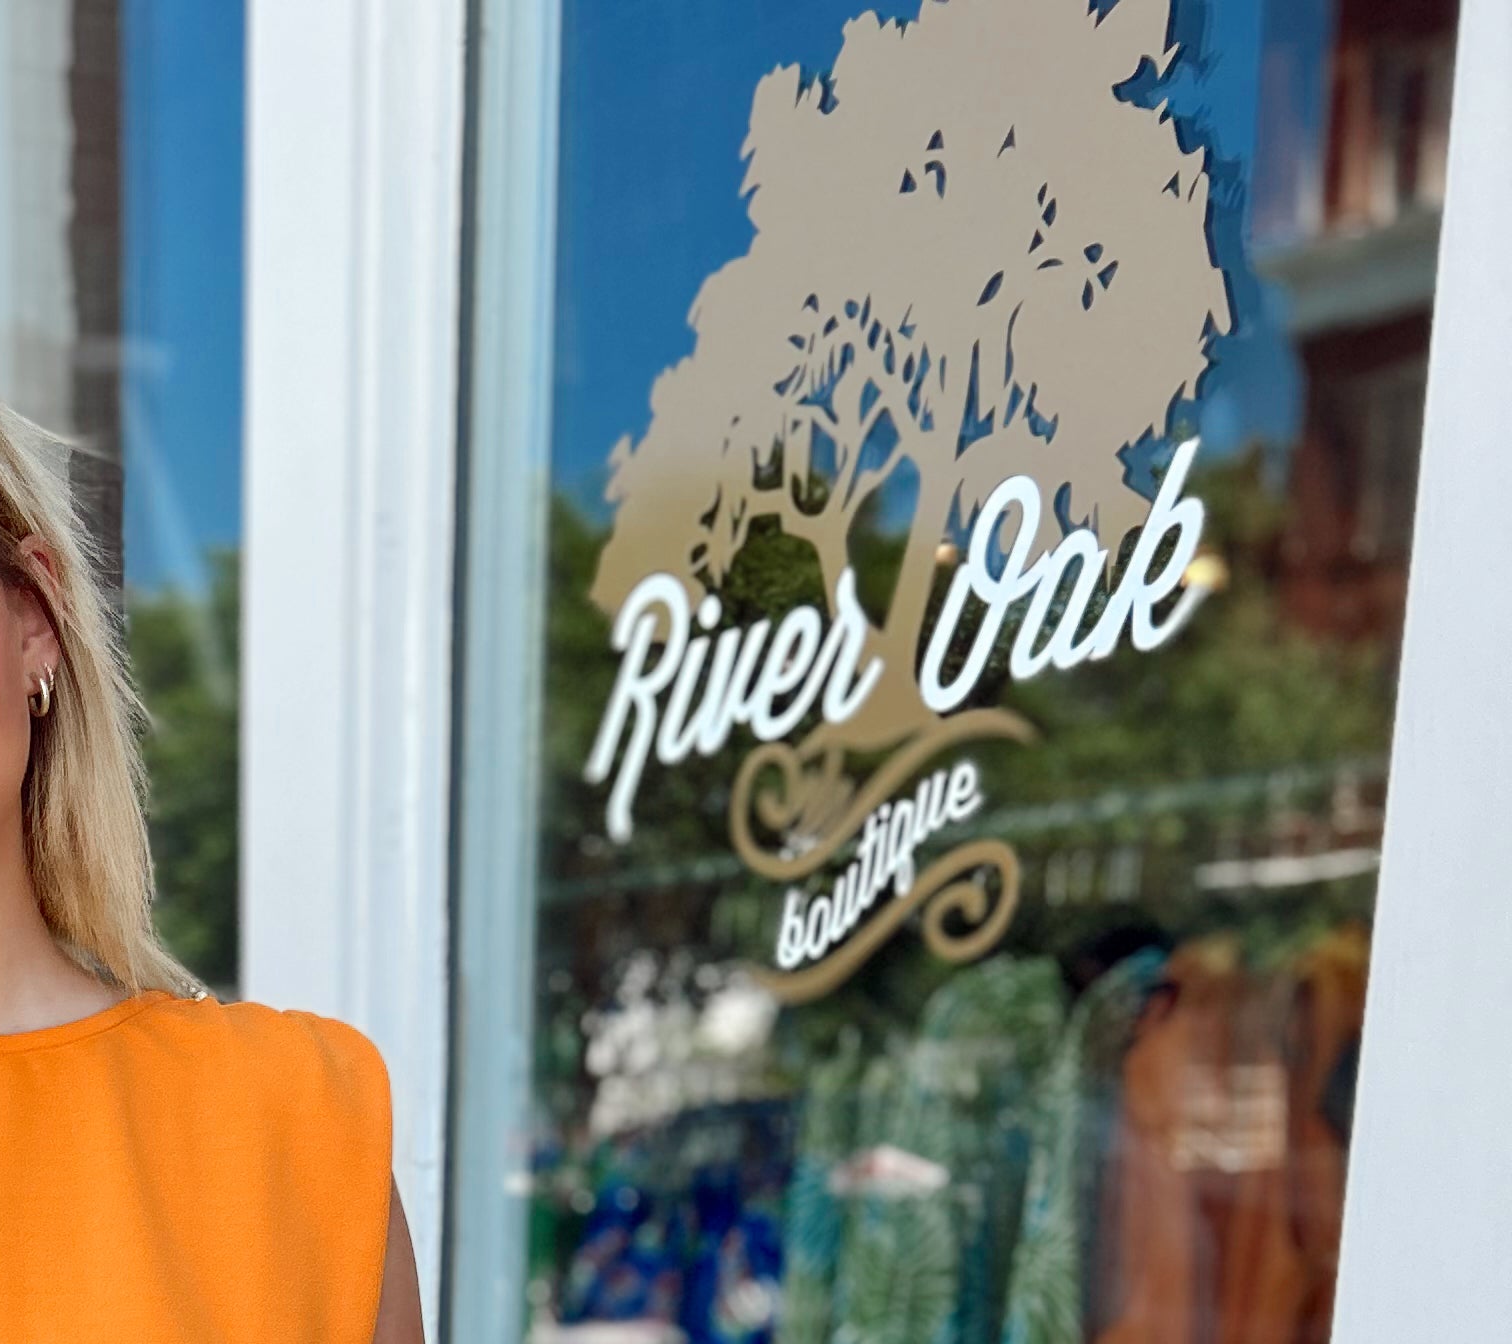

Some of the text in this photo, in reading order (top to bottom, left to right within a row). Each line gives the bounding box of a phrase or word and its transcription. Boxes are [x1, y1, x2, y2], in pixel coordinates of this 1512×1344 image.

[585, 436, 1205, 842] River Oak
[777, 758, 982, 969] boutique
